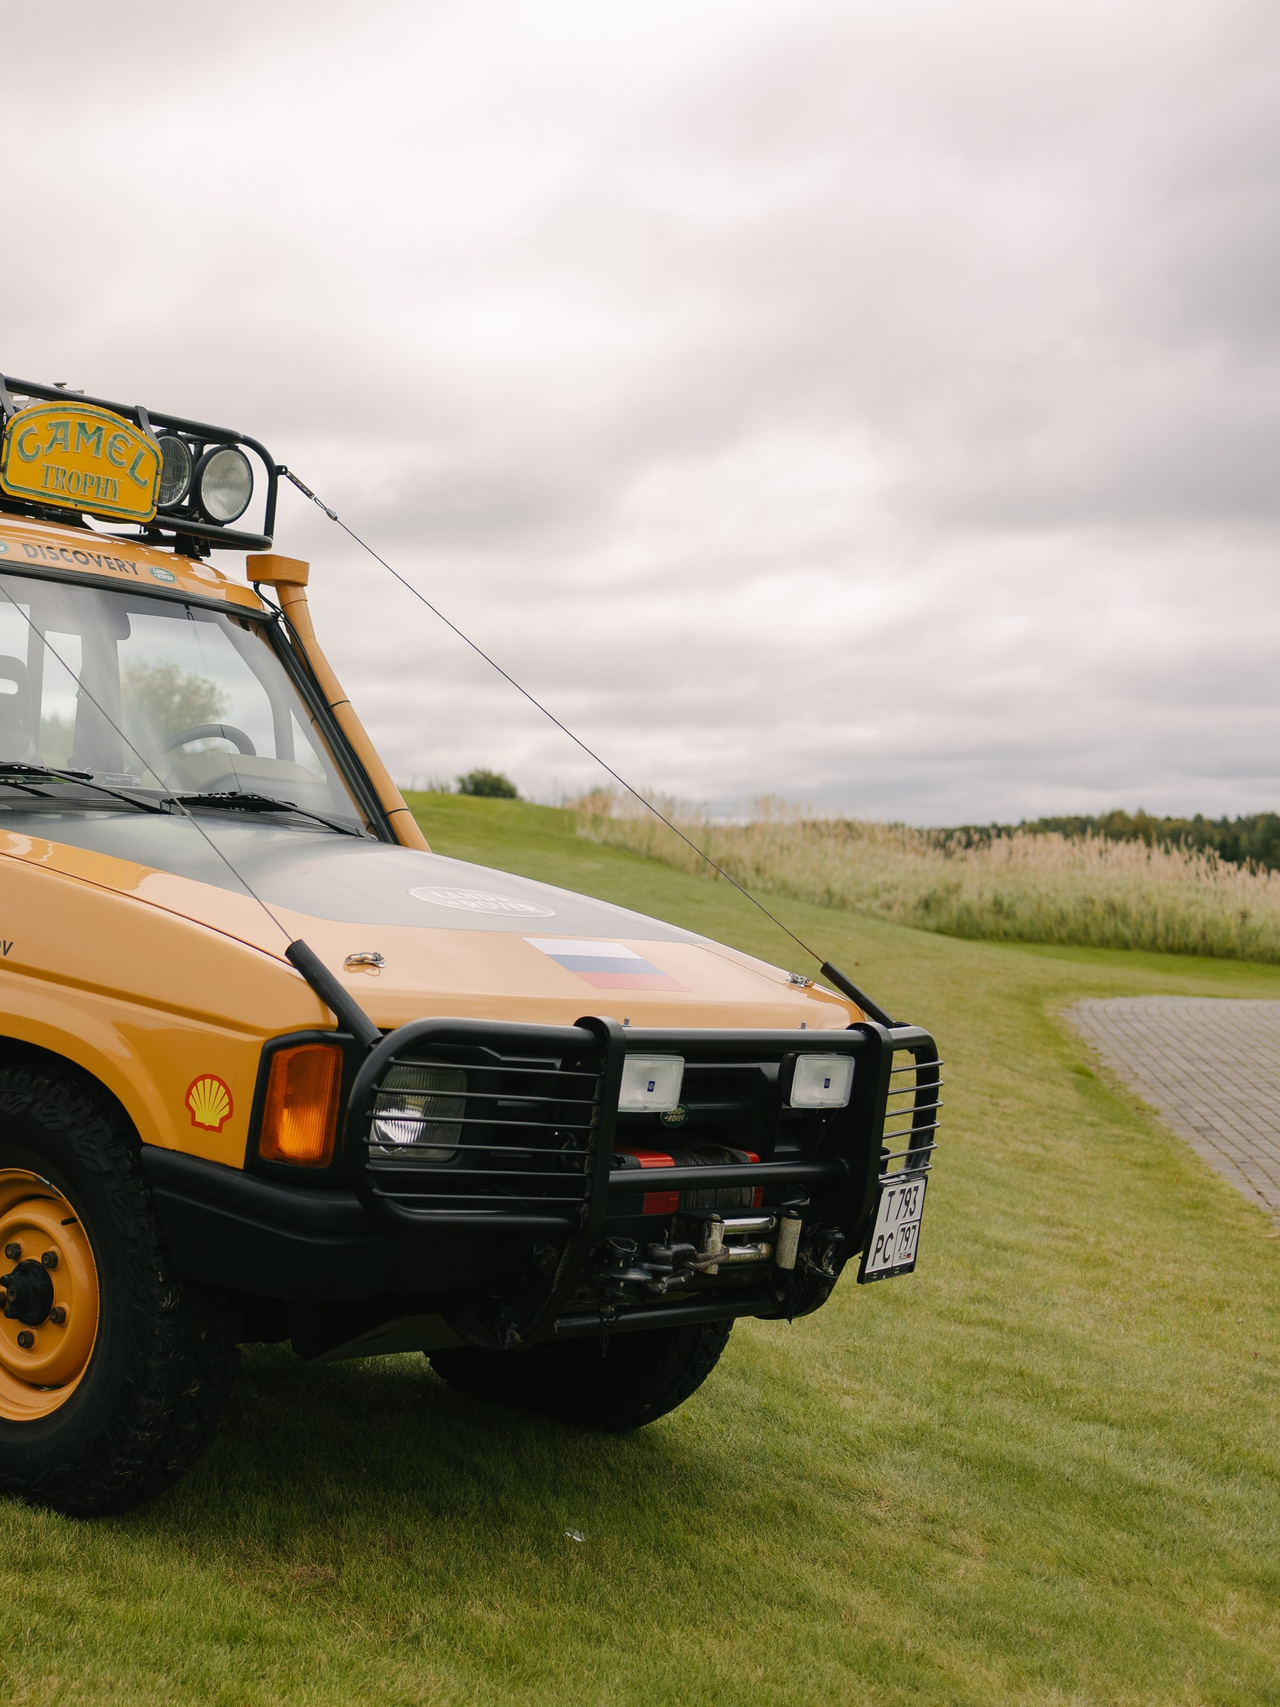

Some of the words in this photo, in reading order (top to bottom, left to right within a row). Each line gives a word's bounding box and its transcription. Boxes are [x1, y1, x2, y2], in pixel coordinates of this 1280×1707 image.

[17, 420, 148, 489] CAMEL
[41, 461, 124, 503] TROPHY
[21, 543, 139, 576] DISCOVERY
[427, 890, 494, 902] LAND
[459, 899, 542, 913] ROVER
[885, 1190, 896, 1223] T
[895, 1185, 919, 1221] 793
[871, 1232, 894, 1267] PC
[898, 1224, 917, 1252] 797
